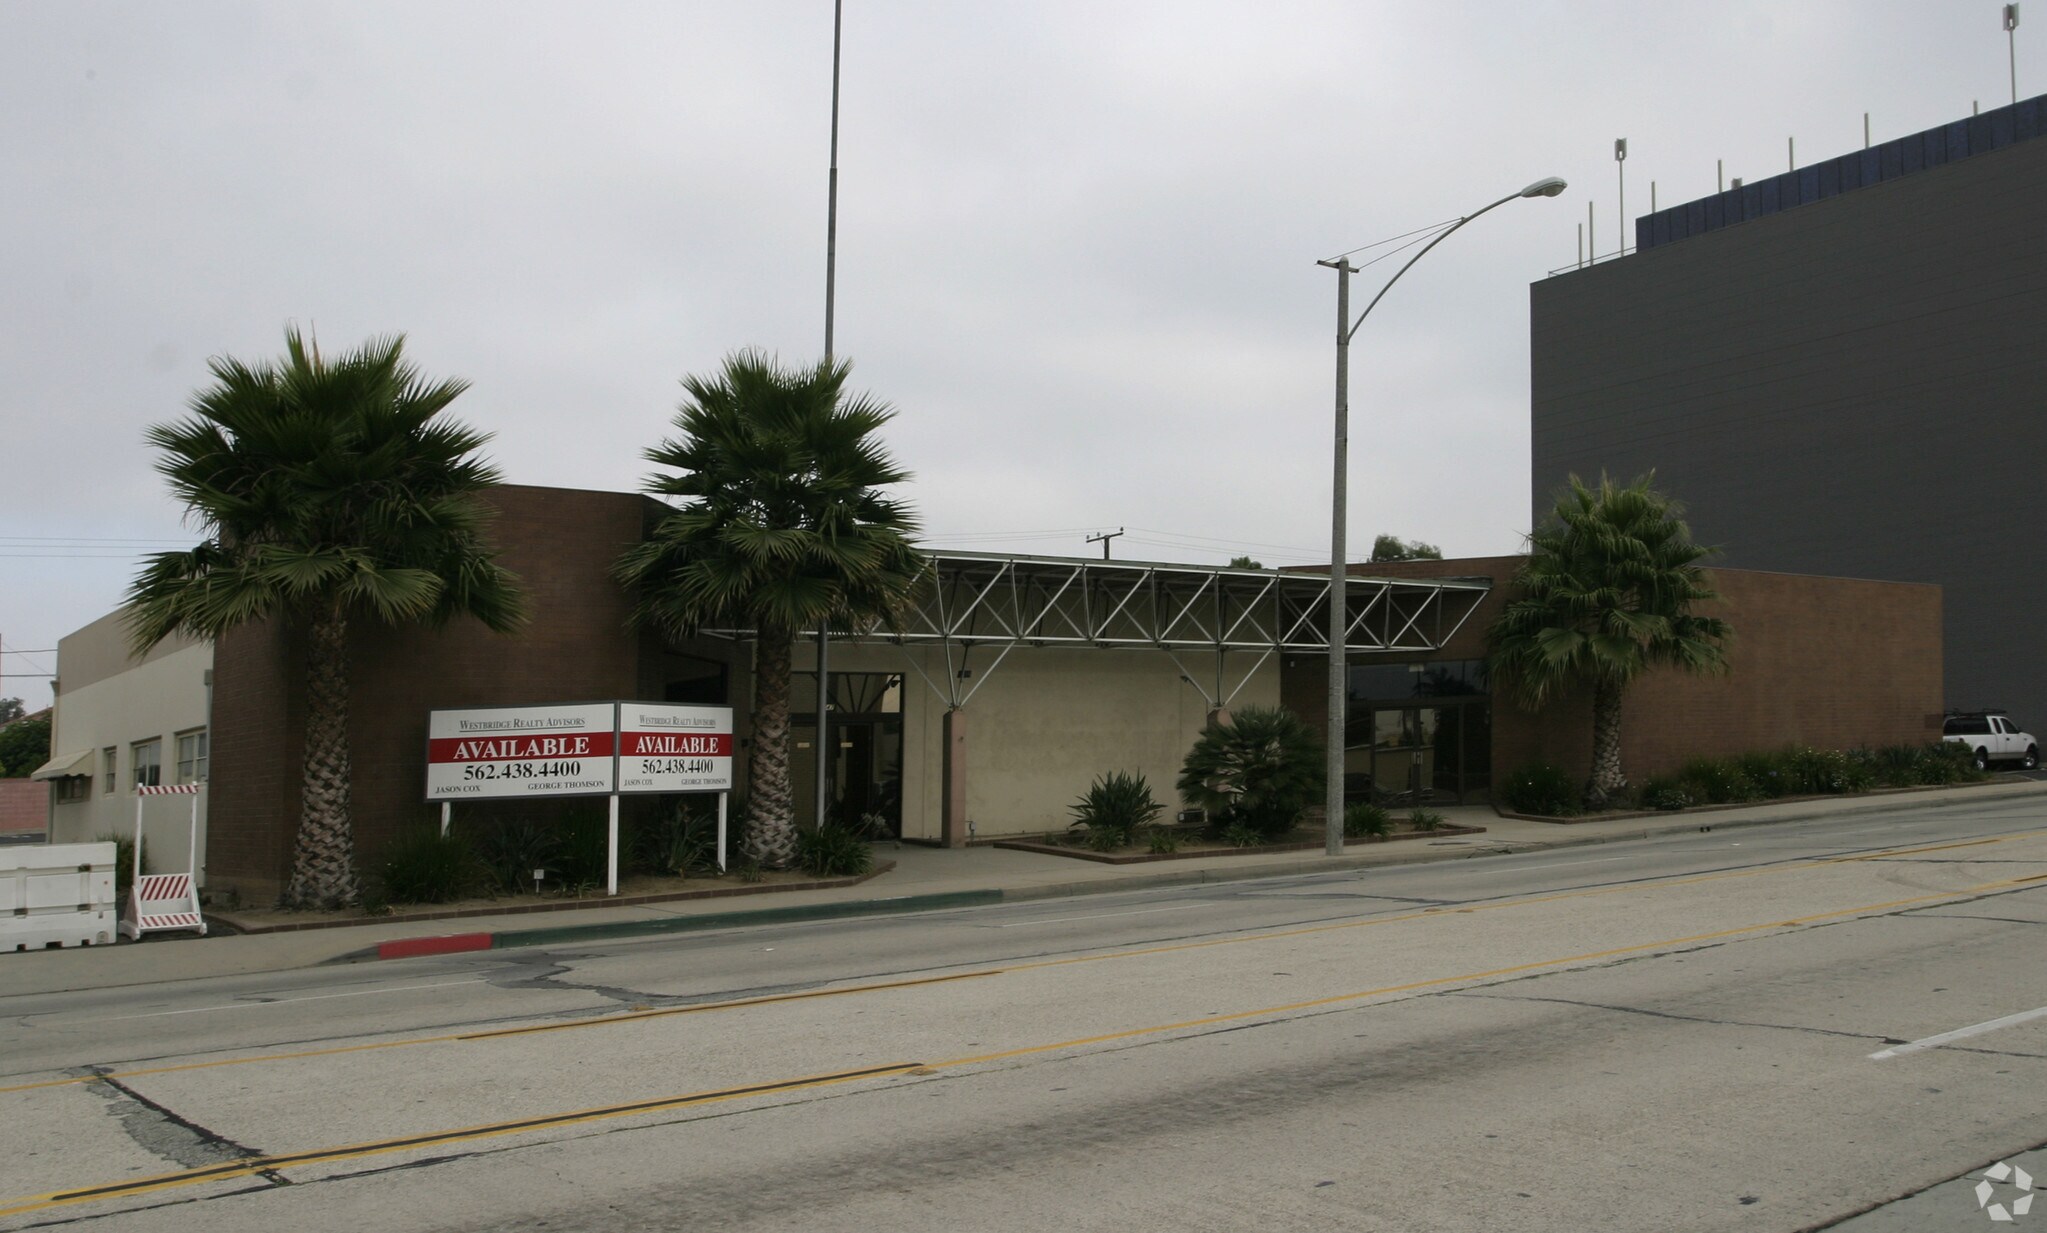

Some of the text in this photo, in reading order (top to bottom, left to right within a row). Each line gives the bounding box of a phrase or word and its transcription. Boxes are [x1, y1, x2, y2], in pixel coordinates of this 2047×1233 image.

[460, 718, 585, 730] WESTBRIDGE REALTY ADVISORS
[673, 717, 691, 725] REALTY
[454, 737, 589, 759] AVAILABLE
[636, 737, 718, 753] AVAILABLE
[464, 761, 580, 781] 562.438.4400
[642, 760, 713, 774] 562.438.4400
